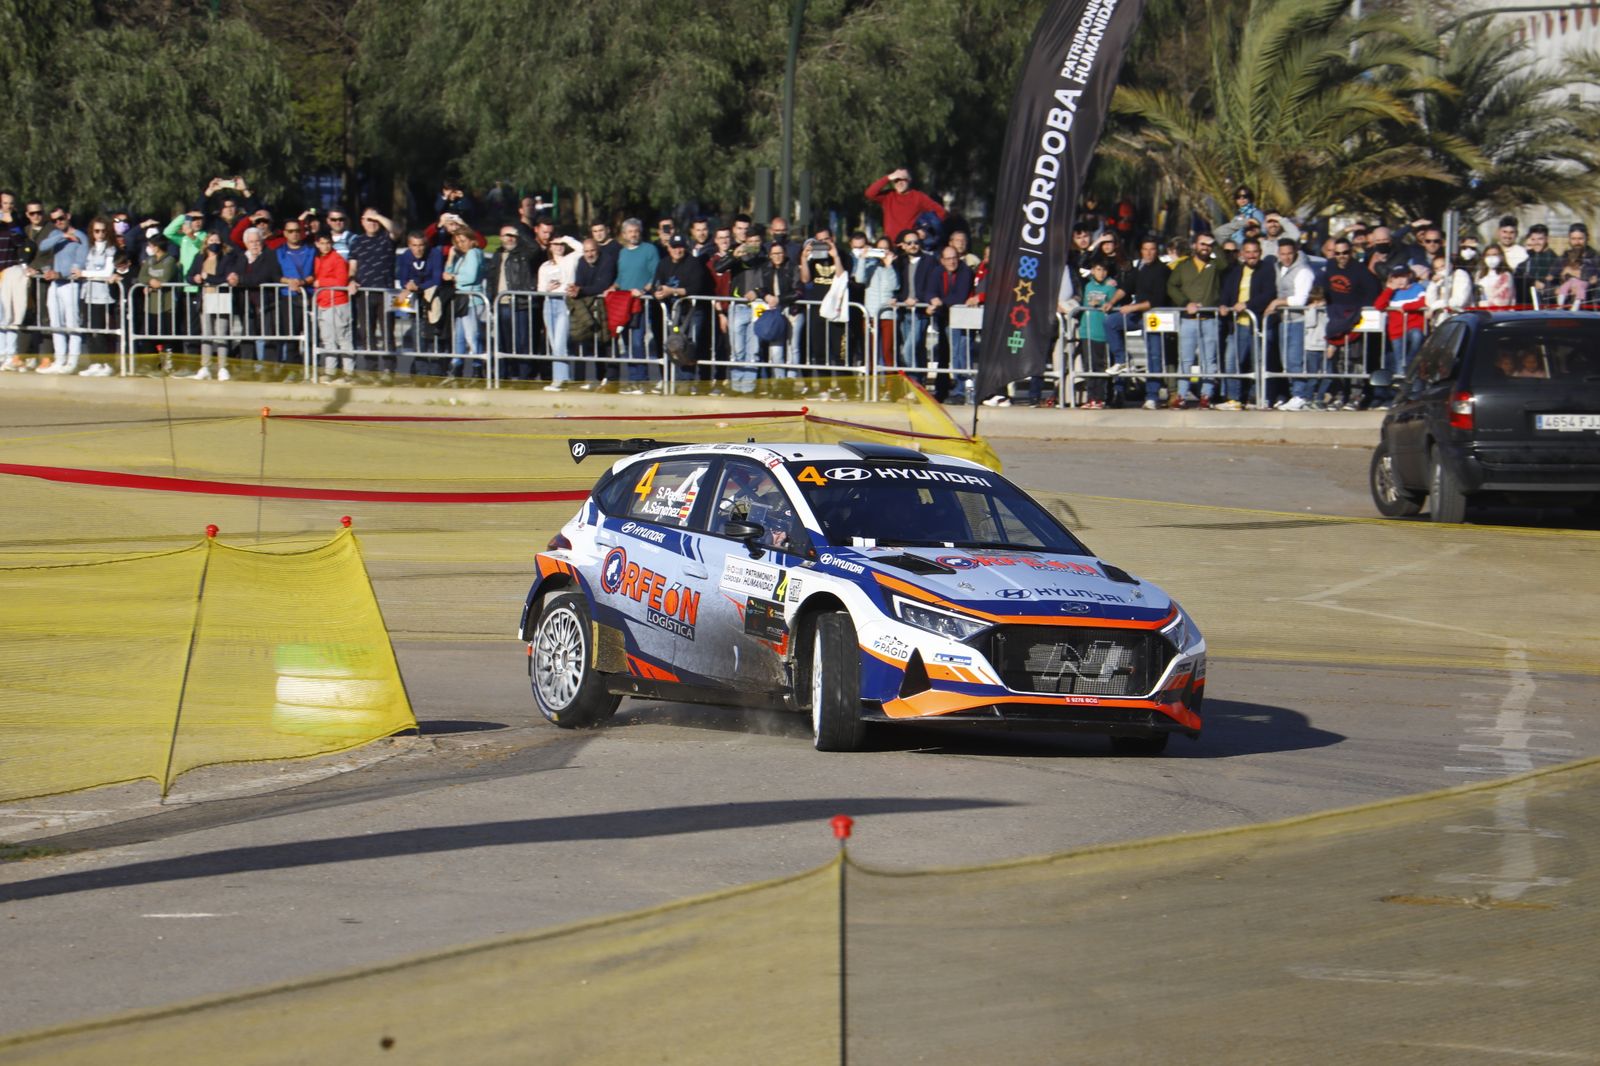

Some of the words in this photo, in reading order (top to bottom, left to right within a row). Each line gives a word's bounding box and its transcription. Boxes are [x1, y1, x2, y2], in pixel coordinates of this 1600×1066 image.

[1022, 89, 1083, 246] CÓRDOBA
[1545, 416, 1575, 428] 4654
[634, 462, 660, 502] 4
[797, 465, 828, 487] 4
[874, 467, 992, 488] HYUNDAI
[633, 525, 666, 544] HYUNDAI
[832, 556, 866, 575] HYUNDAI
[601, 546, 700, 627] ORFEÓN
[776, 573, 789, 602] 4
[1034, 587, 1126, 604] HYUNDAI
[648, 610, 693, 640] LOGÍSTICA
[880, 643, 908, 659] PAGID
